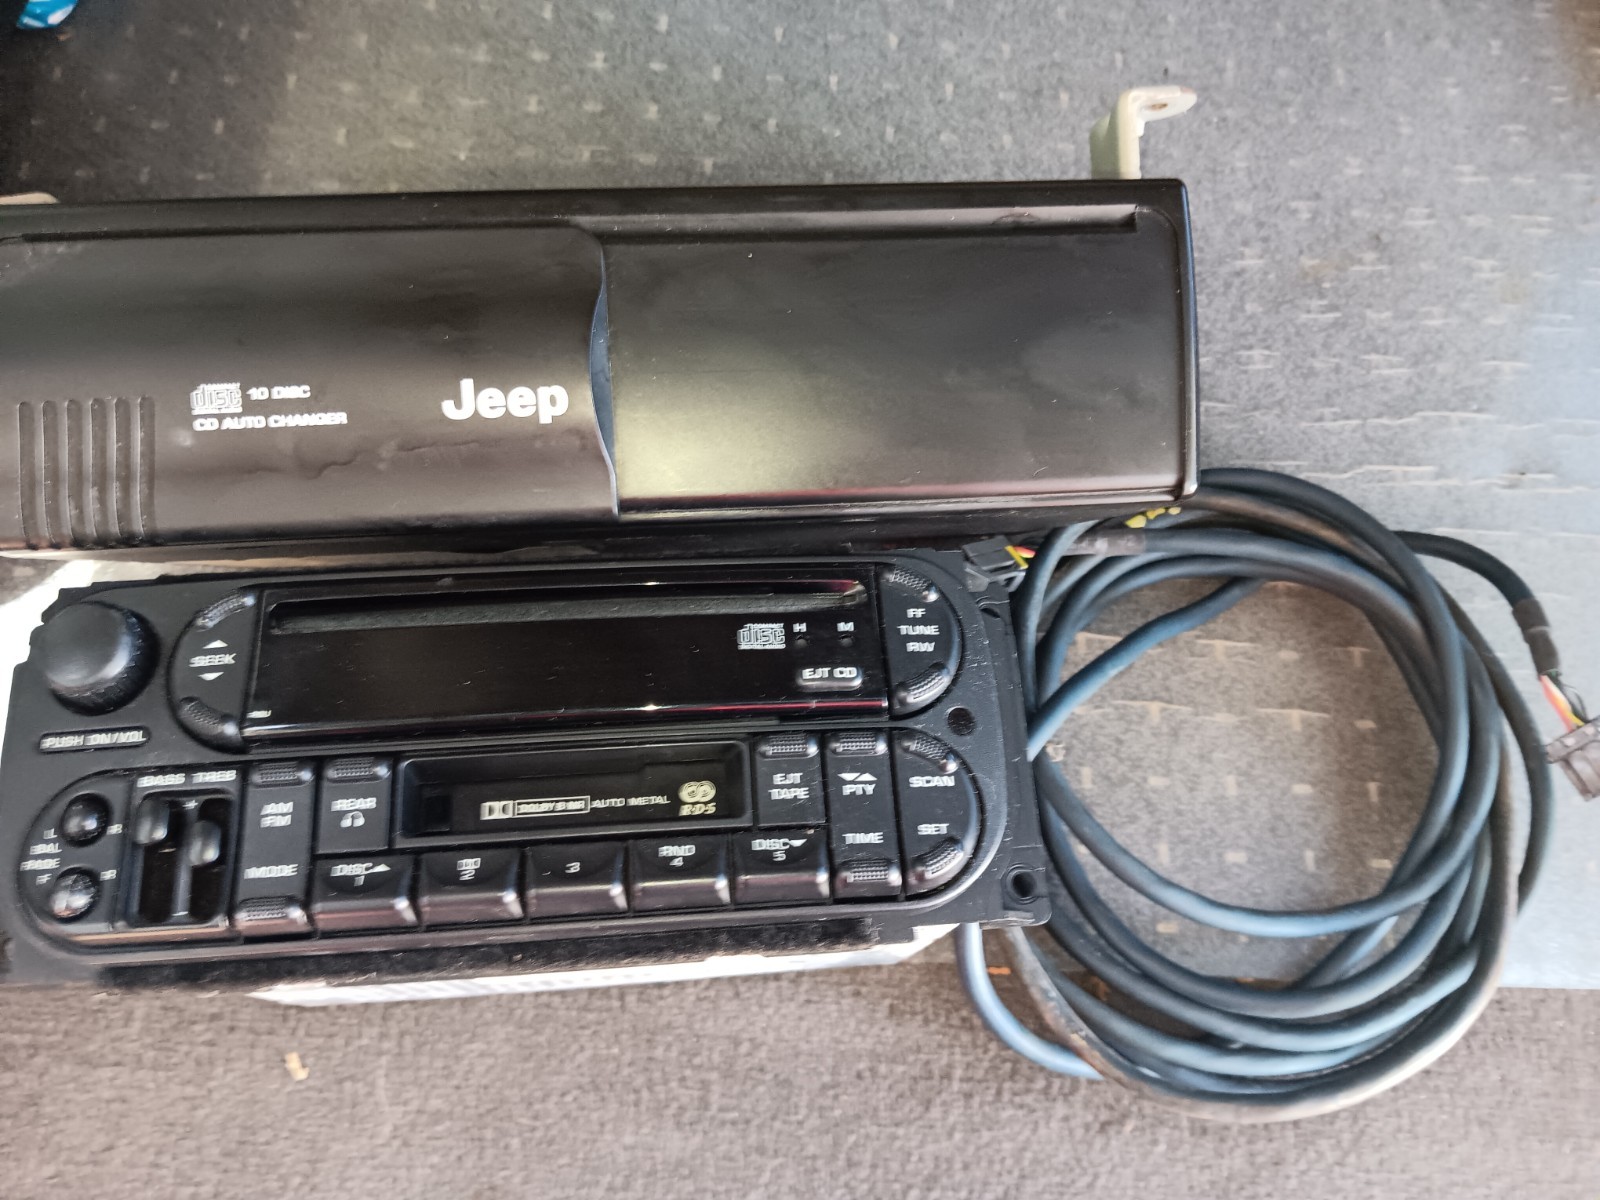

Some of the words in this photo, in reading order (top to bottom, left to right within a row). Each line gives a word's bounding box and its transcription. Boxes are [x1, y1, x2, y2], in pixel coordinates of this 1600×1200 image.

[246, 387, 270, 401] 10
[270, 385, 311, 399] DISC
[441, 378, 569, 424] Jeep
[193, 418, 220, 432] CD
[220, 415, 267, 430] AUTO
[267, 411, 348, 428] CHANGER
[906, 607, 927, 619] FF
[792, 622, 807, 633] H
[836, 622, 855, 632] M
[897, 624, 940, 636] TUNE
[906, 641, 936, 653] RW
[188, 653, 236, 668] SEEK
[802, 667, 831, 680] EJT
[833, 666, 858, 678] CD
[40, 735, 84, 750] PUSH
[136, 772, 186, 788] BASS
[191, 769, 237, 784] TREB
[772, 772, 803, 785] EJT
[909, 775, 956, 788] SCAN
[768, 787, 810, 800] TAPE
[842, 783, 876, 796] PTY
[260, 801, 294, 816] AM
[330, 797, 377, 812] REAR
[590, 797, 626, 809] AUTO
[626, 795, 671, 807] METAL
[260, 814, 292, 828] FM
[917, 823, 949, 836] SET
[751, 838, 791, 851] DISC
[842, 831, 884, 845] TIME
[669, 856, 684, 868] 4
[772, 850, 787, 862] 5
[243, 863, 299, 879] MODE
[330, 862, 373, 877] DISC
[565, 861, 581, 874] 3
[353, 875, 365, 887] 1
[459, 869, 476, 881] 2
